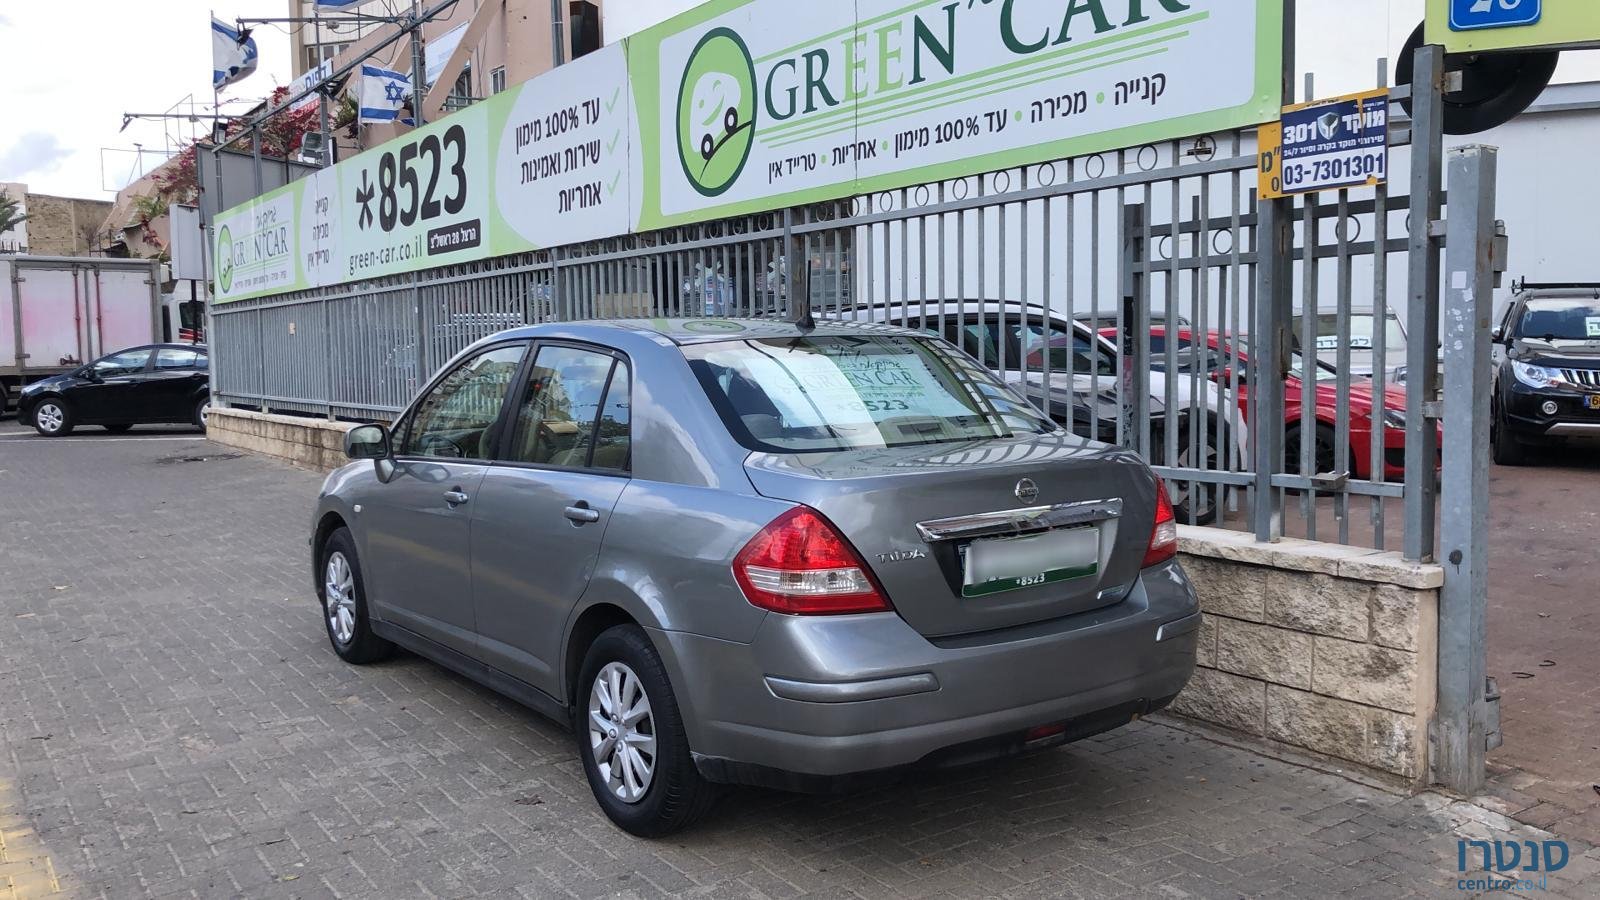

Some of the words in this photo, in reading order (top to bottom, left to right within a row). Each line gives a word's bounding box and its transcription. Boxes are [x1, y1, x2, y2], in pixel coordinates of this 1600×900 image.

[764, 1, 961, 121] GREEN
[1114, 72, 1167, 106] קנייה
[545, 105, 579, 139] 100%
[582, 97, 600, 125] עד
[984, 108, 1007, 133] עד
[1031, 90, 1088, 123] מכירה
[516, 118, 542, 155] מימון
[895, 126, 930, 158] מימון
[935, 115, 980, 144] 100%
[1283, 121, 1317, 145] 301
[521, 151, 561, 185] ואמינות
[564, 138, 601, 173] שירות
[785, 152, 817, 175] טרייד
[831, 139, 877, 166] אחריות
[768, 160, 783, 184] אין
[1284, 152, 1384, 186] 03-7301301
[558, 181, 602, 214] אחריות
[266, 227, 288, 258] CAR
[451, 231, 459, 245] 28
[350, 234, 423, 276] green-car.co.il
[875, 370, 920, 386] CAR
